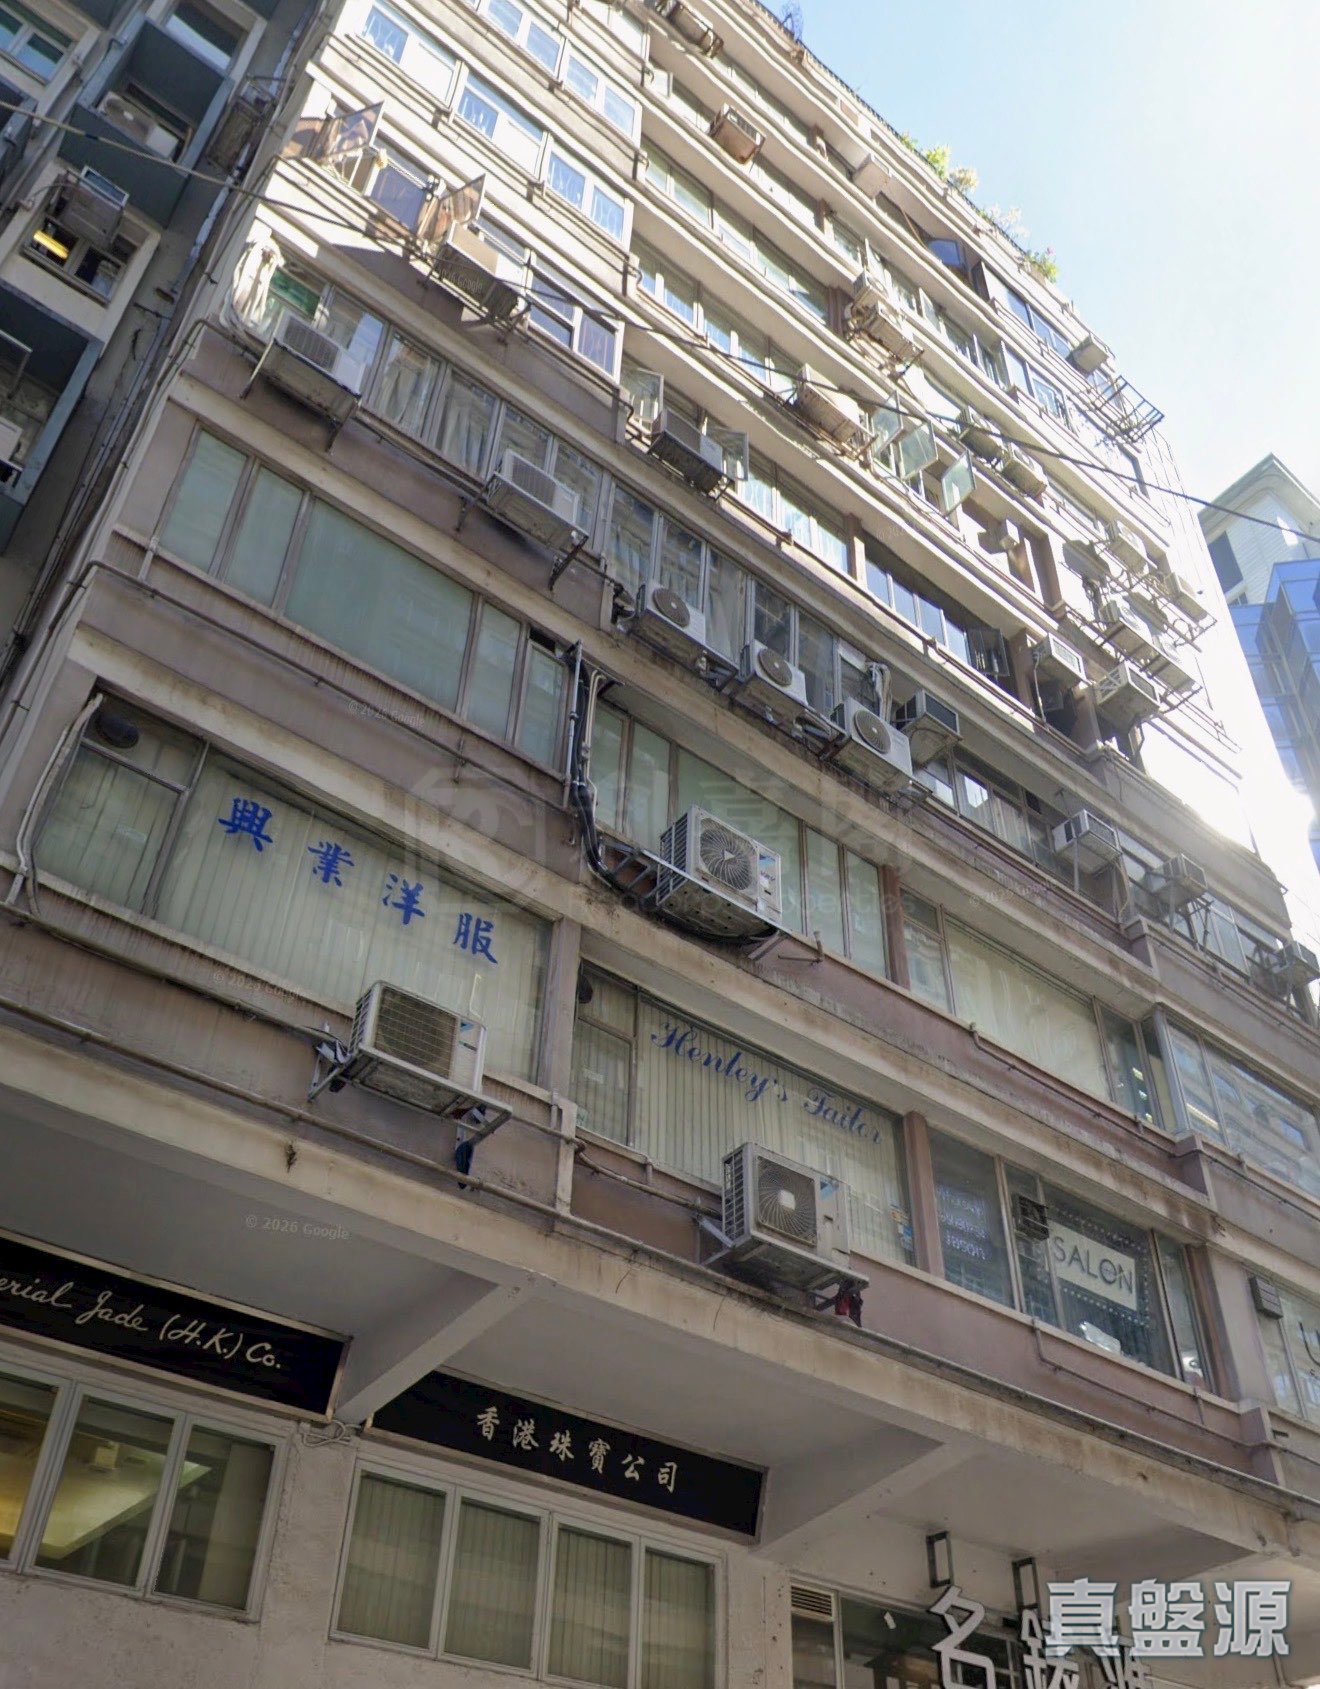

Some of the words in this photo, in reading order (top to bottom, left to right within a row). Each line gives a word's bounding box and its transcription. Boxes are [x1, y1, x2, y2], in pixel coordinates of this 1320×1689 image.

[217, 797, 498, 964] 興業洋服
[651, 1021, 788, 1102] Henley's
[803, 1086, 883, 1145] Tailor
[1052, 1234, 1135, 1294] SALON
[75, 1290, 149, 1332] Jade
[245, 1341, 282, 1369] Co.
[475, 1406, 677, 1493] 香港珠寶公司
